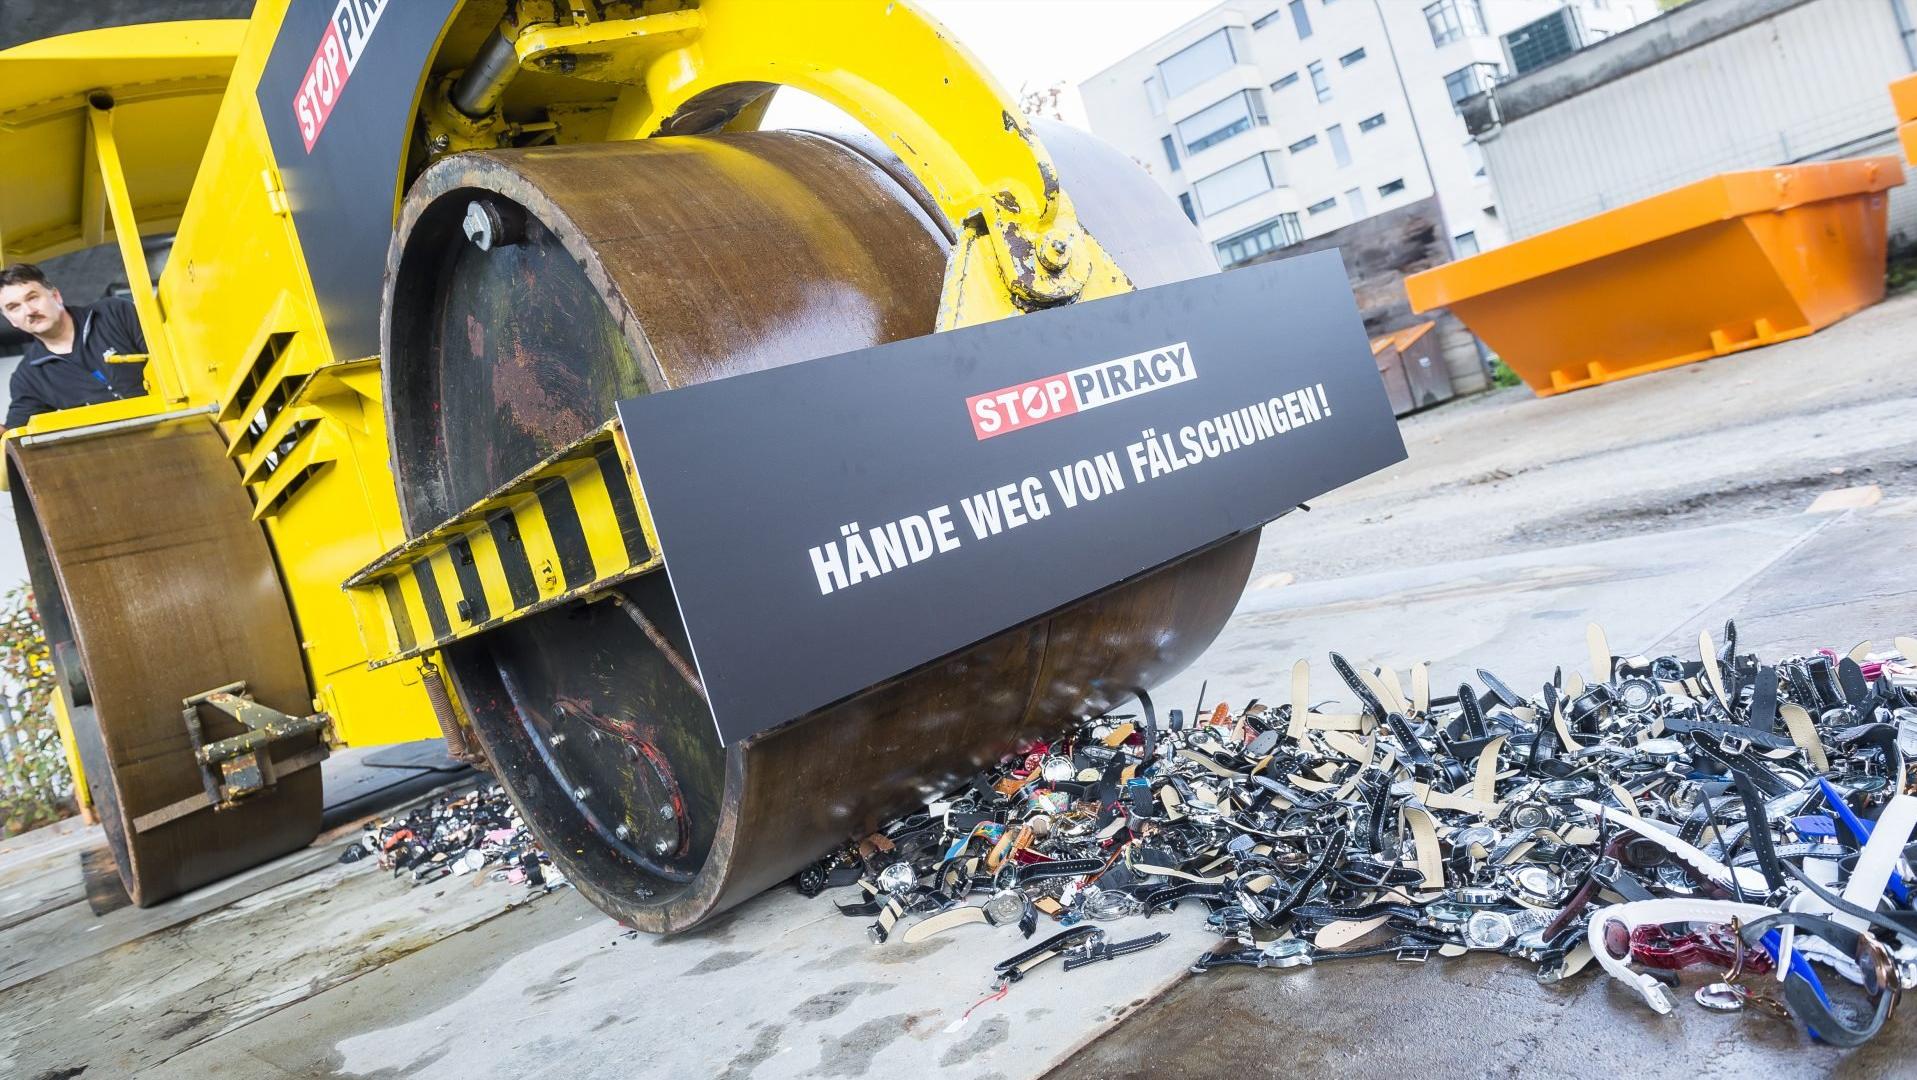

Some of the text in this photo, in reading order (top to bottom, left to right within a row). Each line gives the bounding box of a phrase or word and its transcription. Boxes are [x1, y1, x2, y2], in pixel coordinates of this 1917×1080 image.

[298, 34, 340, 141] STOP
[975, 347, 1191, 433] STOP PIRACY
[808, 383, 1333, 595] HÄNDE WEG VON FÄLSCHUNGEN!
